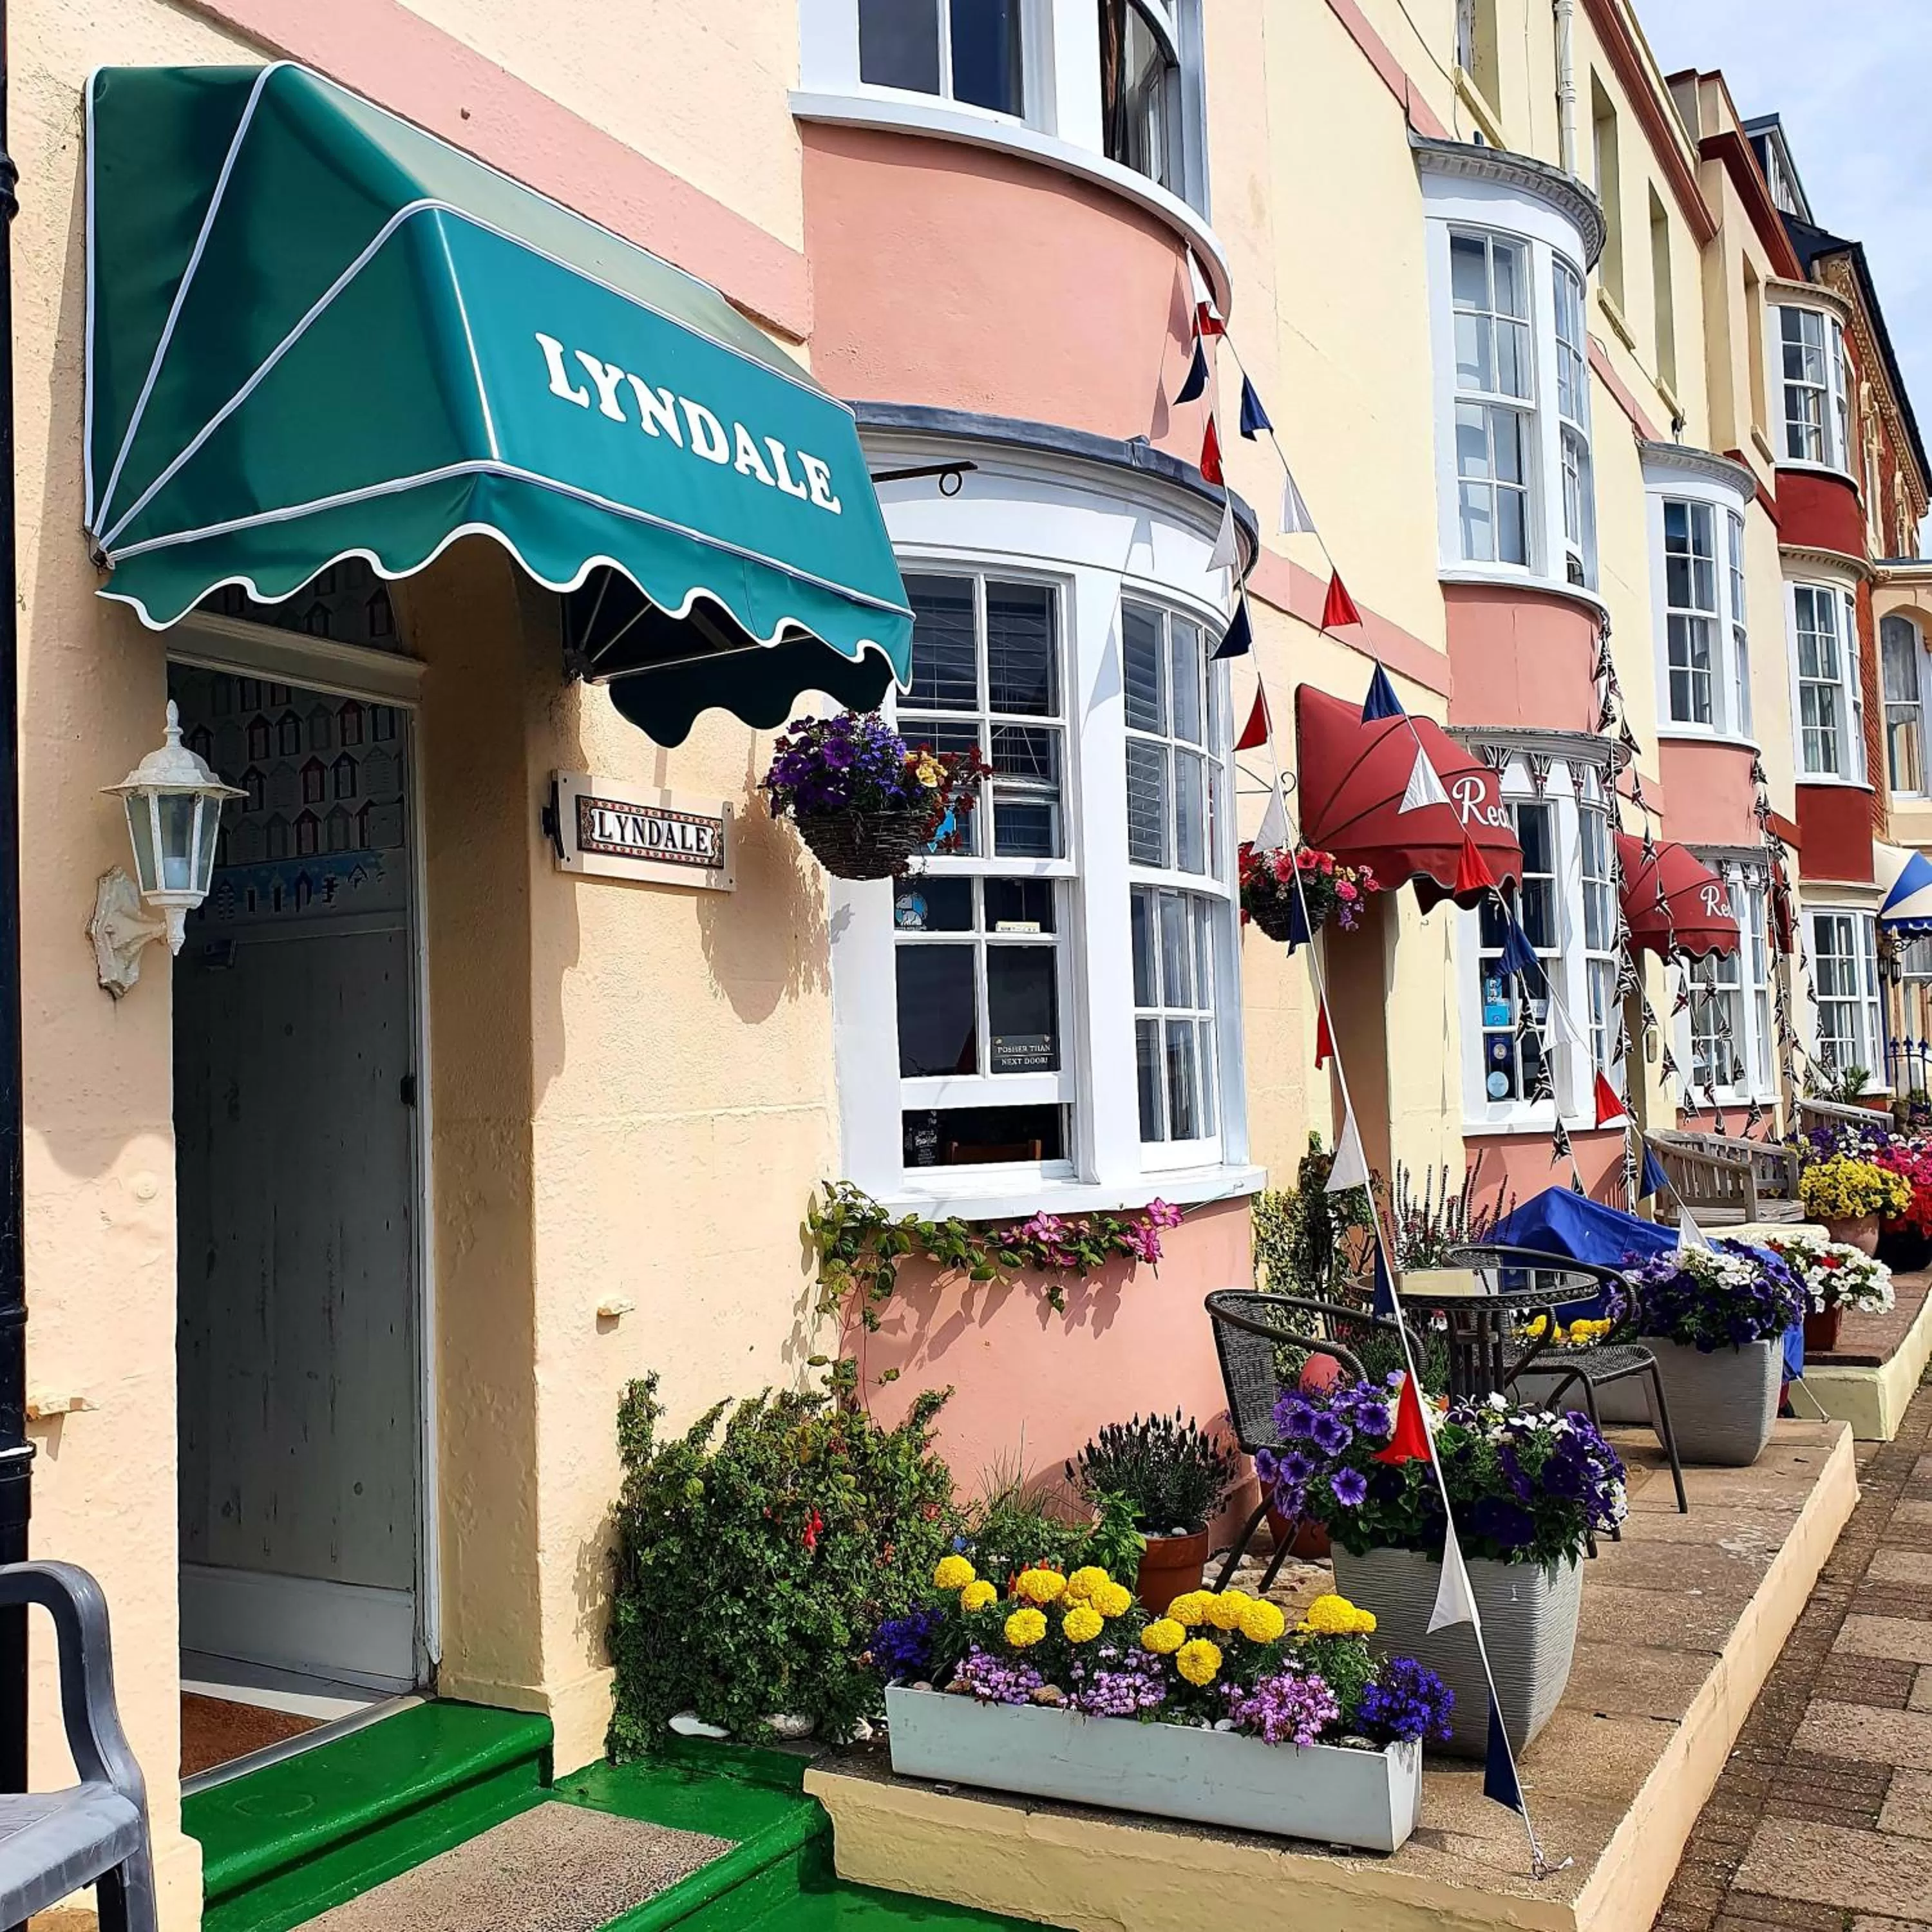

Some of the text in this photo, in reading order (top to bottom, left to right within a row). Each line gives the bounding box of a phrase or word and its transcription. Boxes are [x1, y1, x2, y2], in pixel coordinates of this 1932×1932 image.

[535, 332, 842, 515] LYNDALE
[598, 810, 708, 853] LYNDALE
[997, 1044, 1050, 1054] POSHER THAN
[1001, 1057, 1023, 1066] NEXT
